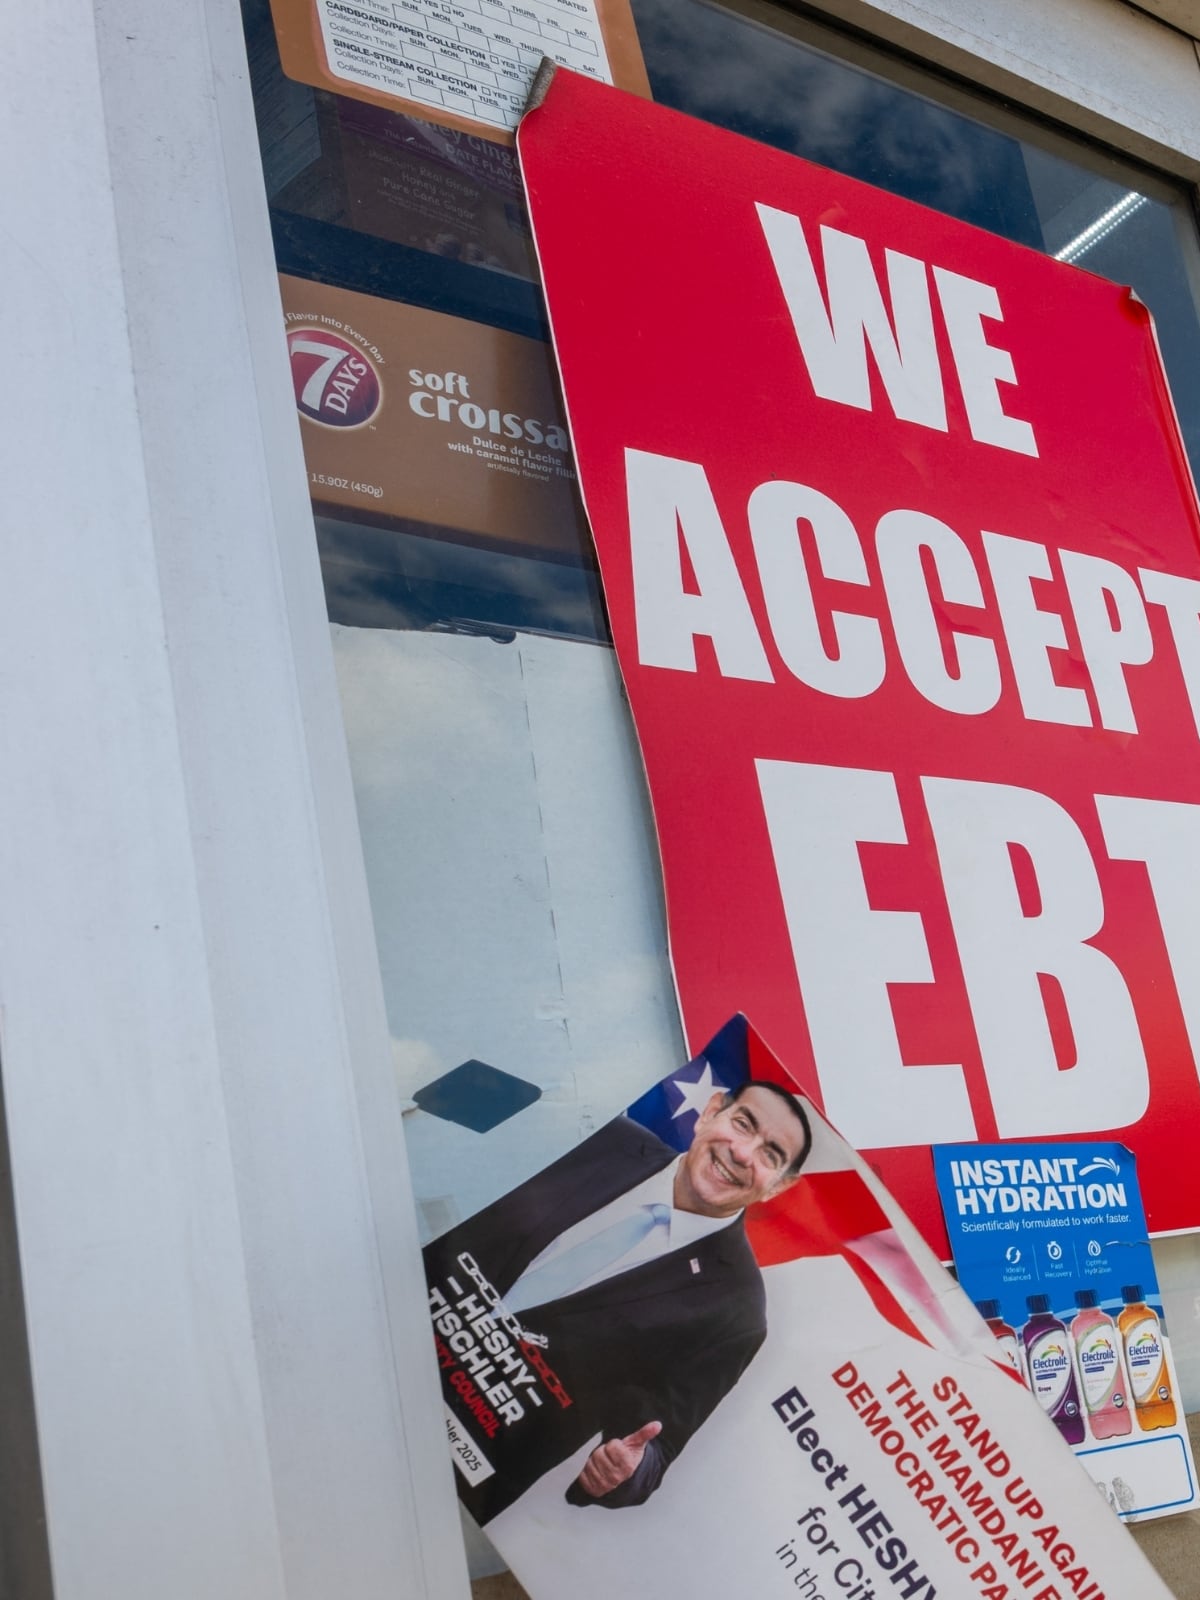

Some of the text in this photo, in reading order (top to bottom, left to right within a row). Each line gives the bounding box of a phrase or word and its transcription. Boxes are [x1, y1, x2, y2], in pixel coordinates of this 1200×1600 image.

[326, 9, 371, 29] Collection
[452, 9, 465, 18] NO
[326, 1, 425, 40] CARDBOARD/PAPER
[425, 34, 487, 61] COLLECTION
[501, 60, 516, 70] YES
[329, 22, 374, 41] Collection
[333, 38, 509, 101] SINGLE-STREAM COLLECTION YES
[334, 47, 378, 68] Collection
[336, 61, 381, 81] Collection
[445, 143, 481, 167] DATE
[286, 312, 386, 365] Flavor Into Every Day
[754, 201, 1040, 459] WE
[290, 340, 350, 412] 7
[324, 357, 368, 415] DAYS
[408, 368, 471, 399] soft
[447, 442, 474, 456] with
[476, 449, 520, 467] caramel
[522, 458, 553, 475] flavor
[472, 436, 562, 467] Dulce de Leche
[351, 480, 384, 498] (450g)
[950, 1158, 1078, 1187] INSTANT
[955, 1183, 1128, 1215] HYDRATION
[961, 1212, 1131, 1233] Scientifically formulated to work faster.
[456, 1294, 537, 1388] HESHY
[1082, 1349, 1115, 1363] Electrolit
[1129, 1343, 1160, 1357] Electrolit
[430, 1287, 525, 1427] TISCHLER
[1033, 1356, 1068, 1370] Electrolit
[450, 1370, 500, 1440] COUNCIL
[771, 1385, 849, 1491] Elect
[932, 1376, 1011, 1478] STAND
[1004, 1476, 1044, 1520] UP
[456, 1442, 483, 1473] 2025
[831, 1360, 980, 1564] DEMOCRATIC
[886, 1369, 1046, 1590] THE MAMDANI
[796, 1506, 841, 1556] for
[776, 1538, 798, 1569] in
